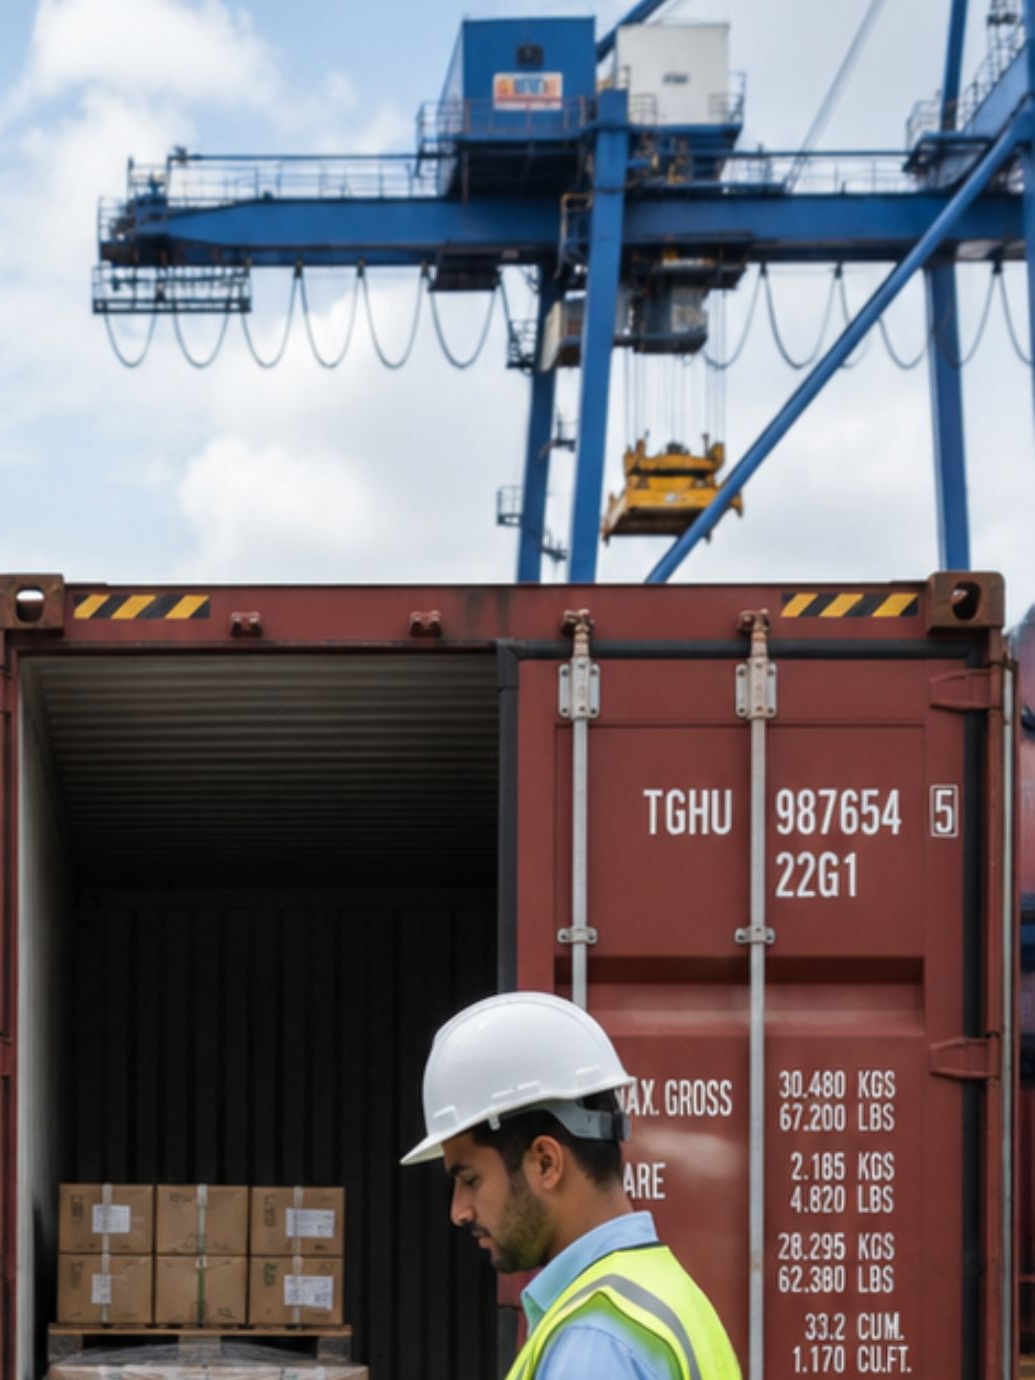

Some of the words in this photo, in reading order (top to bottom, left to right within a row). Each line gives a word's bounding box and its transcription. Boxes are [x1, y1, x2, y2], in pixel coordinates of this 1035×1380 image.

[643, 789, 731, 835] TGHU
[776, 789, 901, 835] 987654
[933, 788, 954, 835] 5
[776, 852, 856, 897] 22G1
[613, 1079, 660, 1116] AX.
[665, 1080, 732, 1116] GROSS
[780, 1070, 845, 1098] 30.480
[858, 1070, 895, 1099] KGS
[780, 1102, 846, 1131] 67.200
[858, 1103, 894, 1131] LBS
[623, 1162, 666, 1199] ARE
[791, 1152, 845, 1180] 2.185
[858, 1152, 894, 1181] KGS
[791, 1185, 845, 1213] 4.820
[858, 1184, 893, 1213] LBS
[779, 1232, 845, 1260] 28.295
[858, 1232, 894, 1260] KGS
[779, 1265, 845, 1293] 62.380
[858, 1265, 893, 1293] LBS
[805, 1313, 845, 1340] 33.2
[793, 1345, 845, 1373] 1.170
[857, 1345, 911, 1373] CU.FT.
